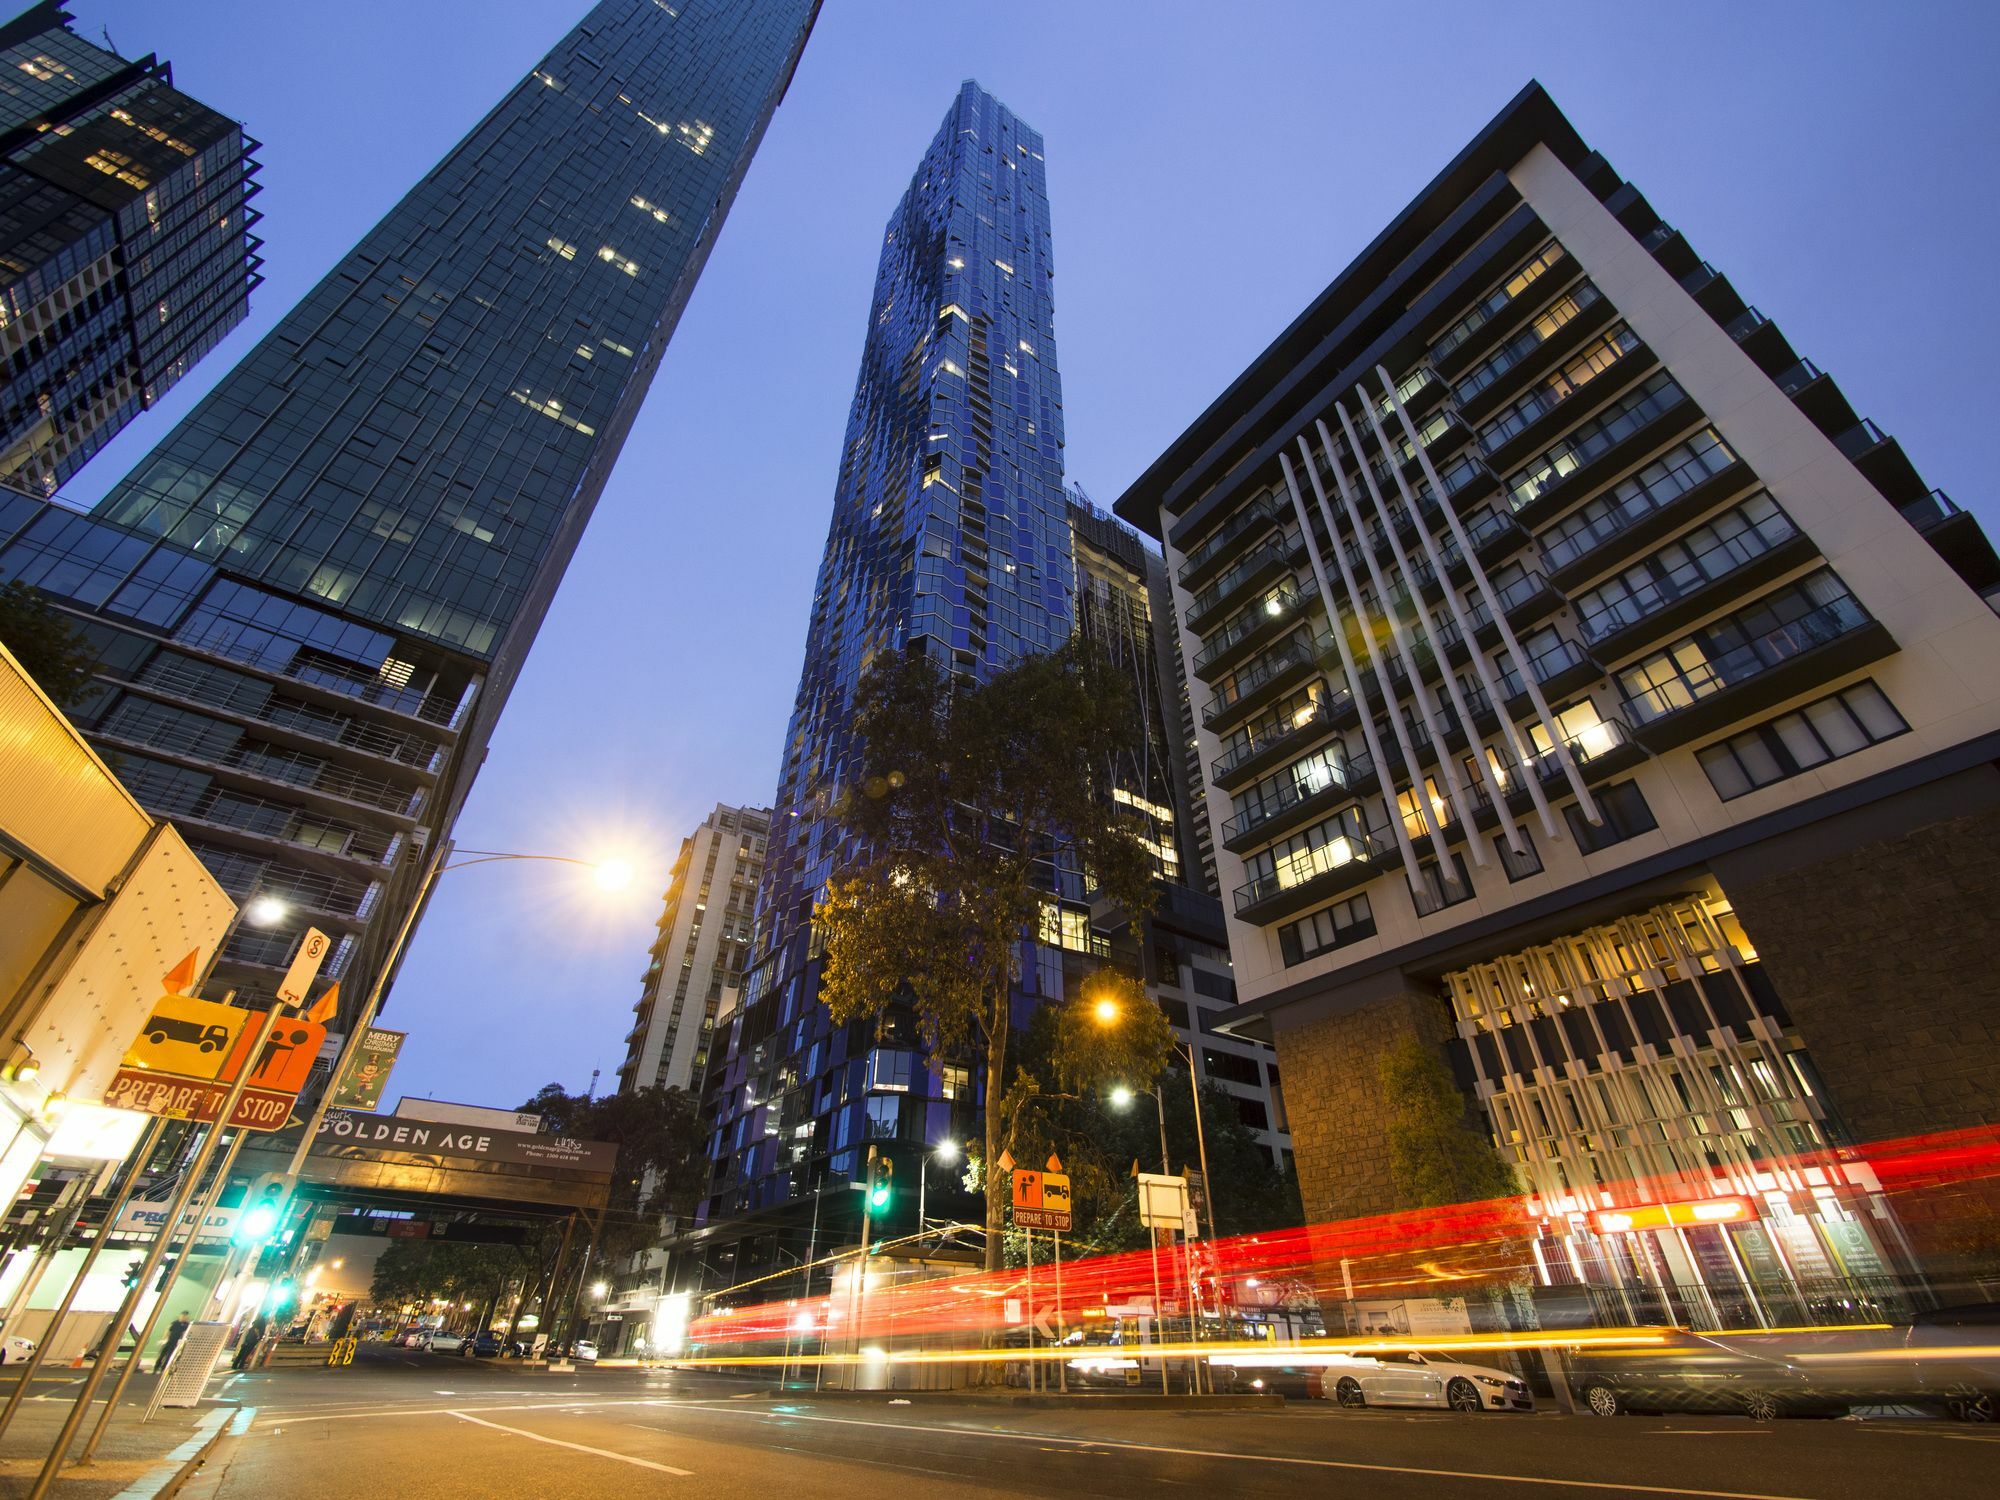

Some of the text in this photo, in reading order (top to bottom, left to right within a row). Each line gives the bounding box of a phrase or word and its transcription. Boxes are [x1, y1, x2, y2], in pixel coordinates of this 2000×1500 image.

[368, 1031, 401, 1043] MERRY
[362, 1044, 395, 1054] MELBOURNE
[365, 1038, 398, 1049] CHRISTMAS
[113, 1077, 203, 1111] PREPARE
[238, 1096, 286, 1123] STOP
[316, 1119, 491, 1153] GOLDEN AGE
[525, 1150, 544, 1158] Phone:
[1015, 1211, 1070, 1227] PREPARE TO STOP
